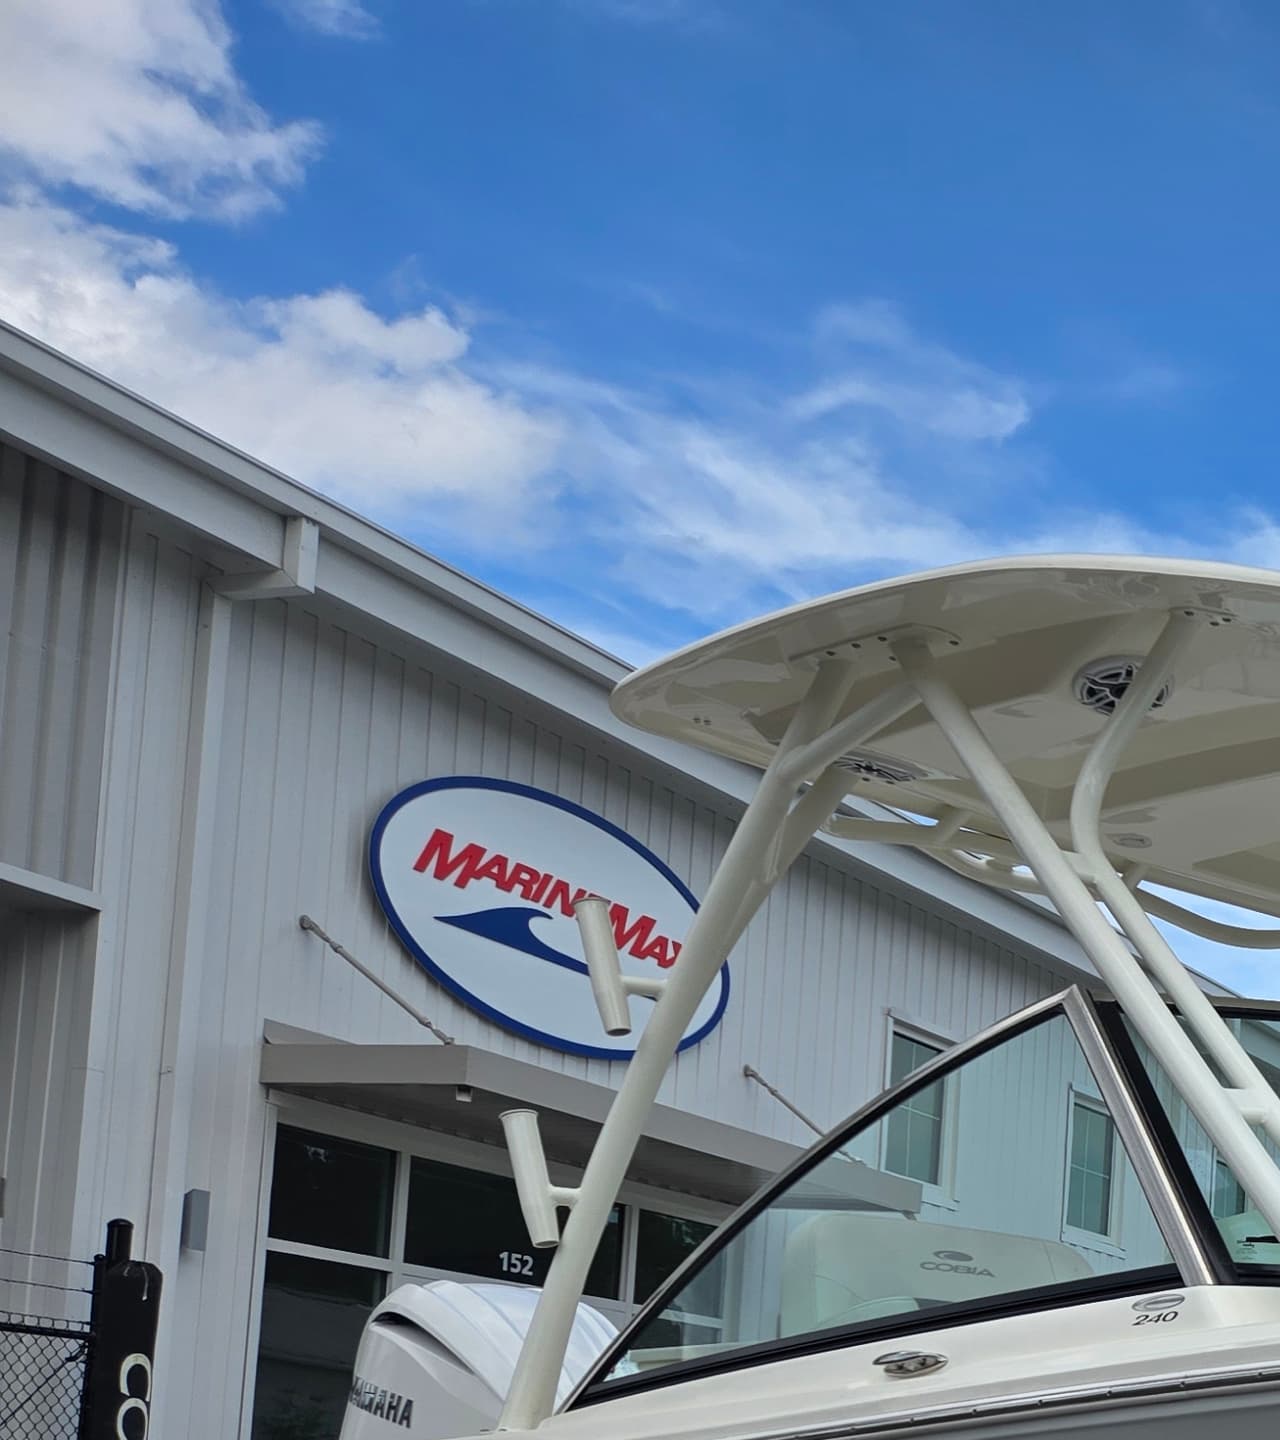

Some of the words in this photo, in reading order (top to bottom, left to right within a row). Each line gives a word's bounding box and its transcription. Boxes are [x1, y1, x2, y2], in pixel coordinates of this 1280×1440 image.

[412, 828, 682, 968] MARINMA
[499, 1251, 534, 1276] 152
[920, 1262, 995, 1277] COBIA
[1131, 1311, 1178, 1326] 240
